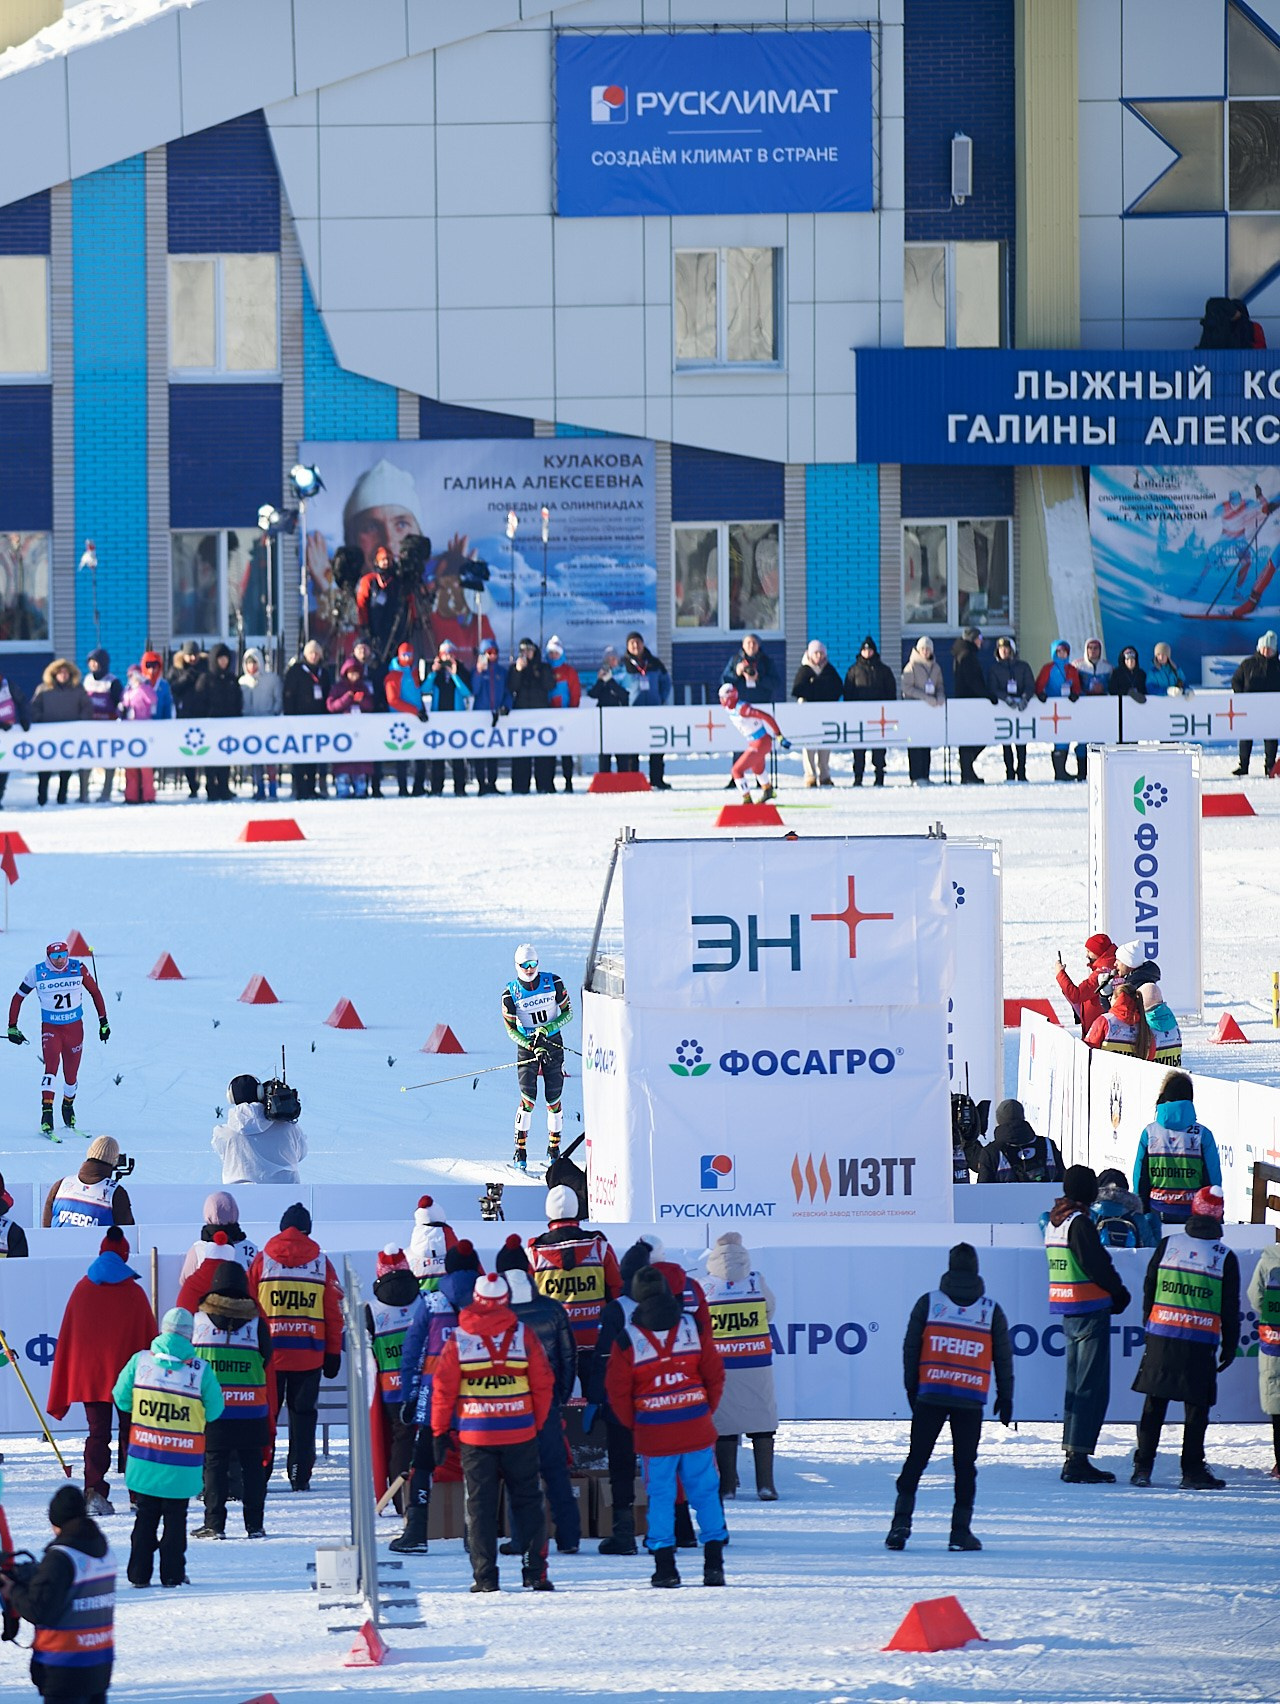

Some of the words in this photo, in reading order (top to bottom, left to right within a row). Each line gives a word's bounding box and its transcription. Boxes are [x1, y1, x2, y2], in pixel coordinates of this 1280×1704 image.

[636, 88, 839, 116] РУСКЛИМАТ
[591, 147, 677, 167] СОЗДАЁМ
[681, 148, 753, 164] КЛИМАТ
[757, 148, 769, 163] В
[772, 147, 839, 162] СТРАНЕ
[1014, 365, 1211, 400] ЛЫЖНЫЙ
[948, 414, 1116, 445] ГАЛИНЫ
[544, 454, 644, 468] КУЛАКОВА
[444, 476, 516, 490] ГАЛИНА
[522, 475, 644, 488] АЛЕКСЕЕВНА
[561, 501, 644, 511] ОЛИМПИАДАХ
[1146, 510, 1208, 521] КУЛАКОВОЙ
[218, 733, 352, 756] ФОСАГРО
[423, 727, 558, 750] ФОСАГРО
[13, 738, 147, 760] ФОСАГРО
[47, 980, 81, 989] ФОСАГРО
[54, 993, 71, 1009] 21
[1187, 1125, 1200, 1134] 25
[839, 1157, 916, 1197] ИЗТТ
[1150, 1166, 1197, 1178] ВОЛОНТЕР
[105, 1179, 116, 1189] 12
[660, 1203, 776, 1218] РУСКЛИМАТ
[850, 1209, 886, 1217] ТЕПЛОВОЙ
[888, 1209, 916, 1217] ТЕХНИКИ
[243, 1246, 255, 1257] 12
[1211, 1245, 1225, 1255] 48
[545, 1275, 597, 1294] СУДЬЯ
[1162, 1280, 1213, 1299] ВОЛОНТЕР
[270, 1290, 317, 1309] СУДЬЯ
[710, 1311, 759, 1331] СУДЬЯ
[1158, 1310, 1214, 1327] УДМУРТИЯ
[930, 1335, 984, 1358] ТРЕНЕР
[187, 1360, 201, 1370] 46
[139, 1399, 191, 1422] СУДЬЯ
[463, 1400, 525, 1415] УДМУРТИЯ
[135, 1430, 195, 1449] УДМУРТИЯ
